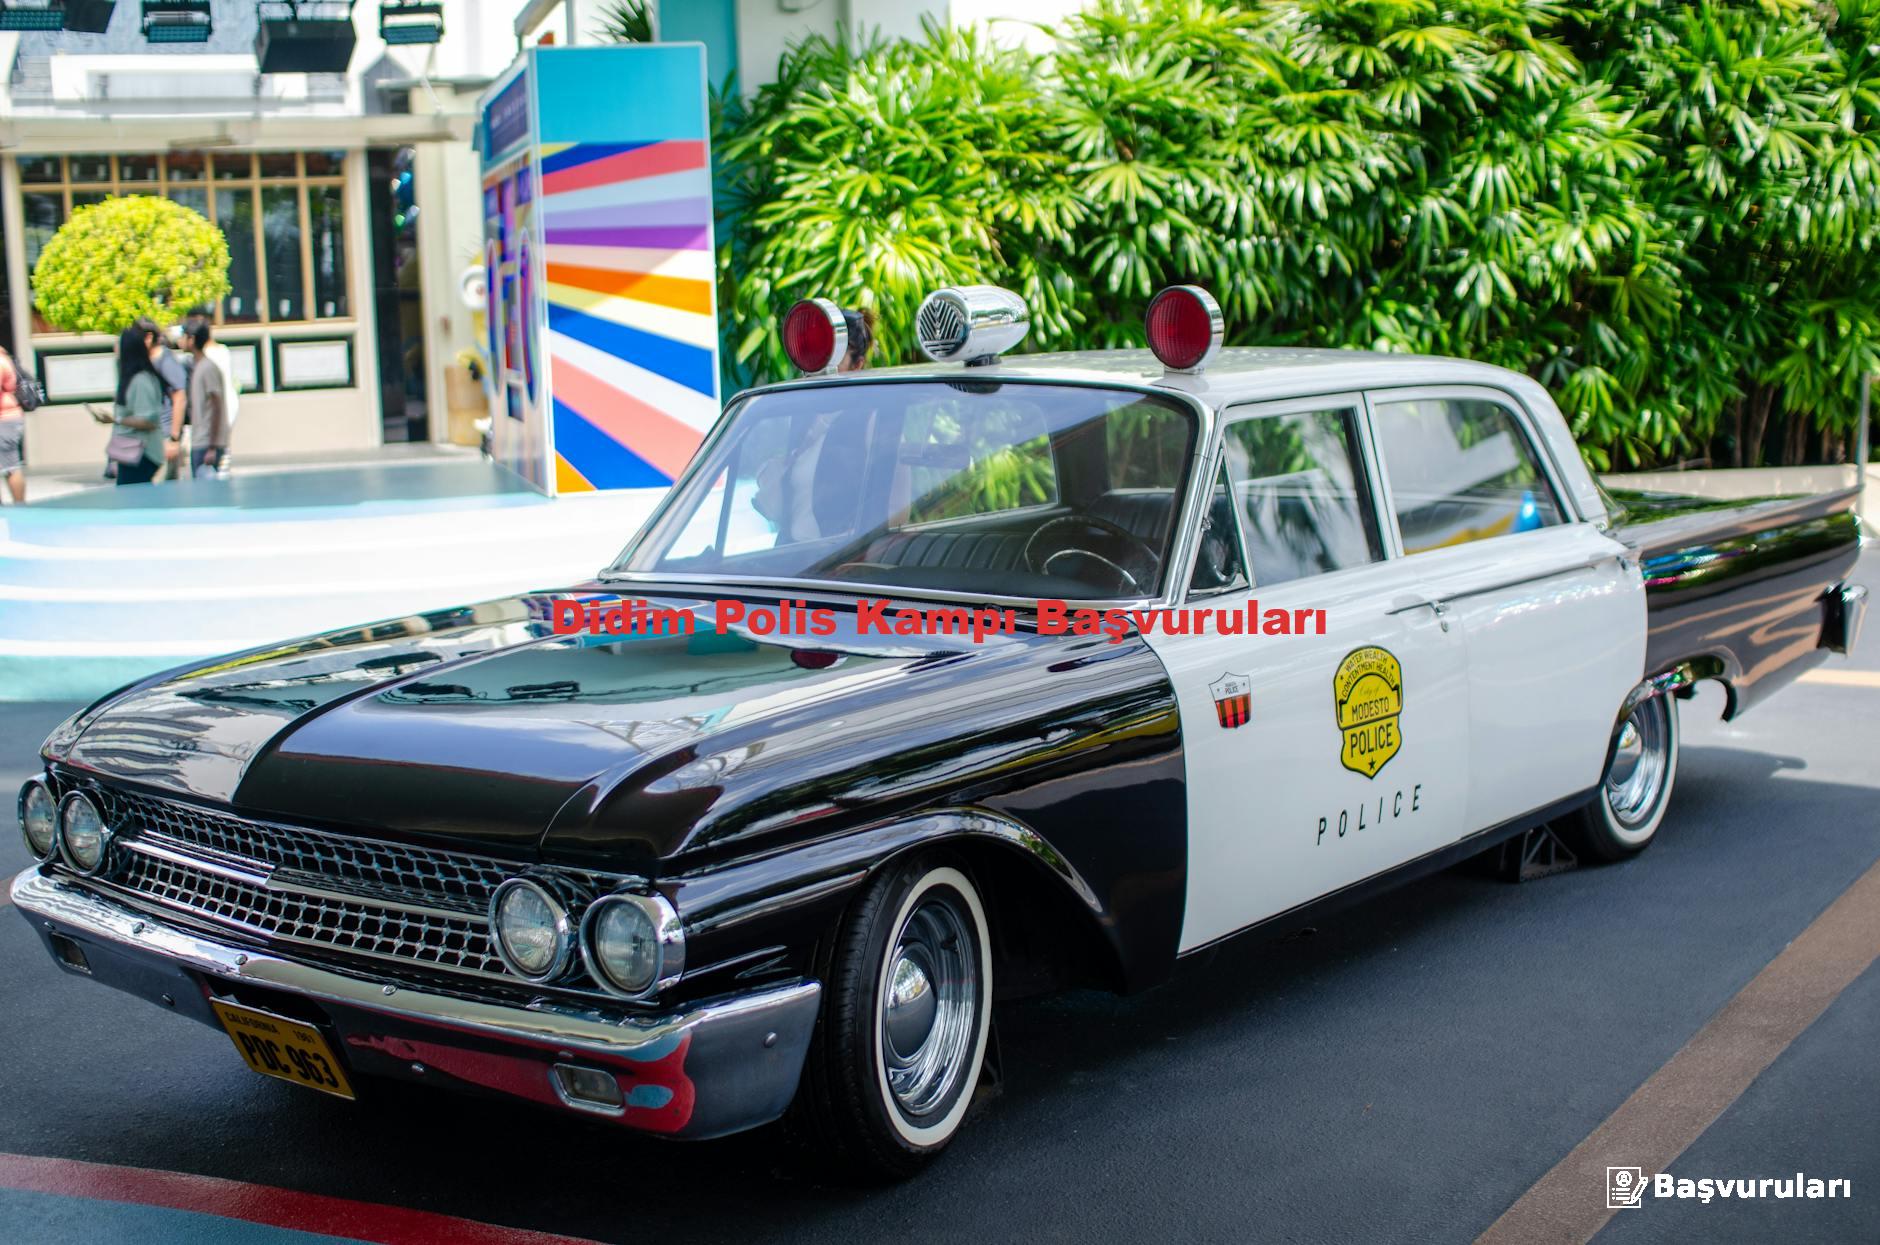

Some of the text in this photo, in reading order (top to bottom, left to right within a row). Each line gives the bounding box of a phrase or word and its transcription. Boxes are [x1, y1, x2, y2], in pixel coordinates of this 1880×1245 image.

[1345, 650, 1388, 672] WATER WEALTH
[1342, 661, 1396, 698] CONTENTMENT HEALTH
[1351, 697, 1390, 721] MODESTO
[1350, 722, 1394, 758] POLICE
[1317, 784, 1422, 846] POLICE
[224, 1011, 281, 1035] CALIFORNIA
[236, 1030, 339, 1089] PDC 963
